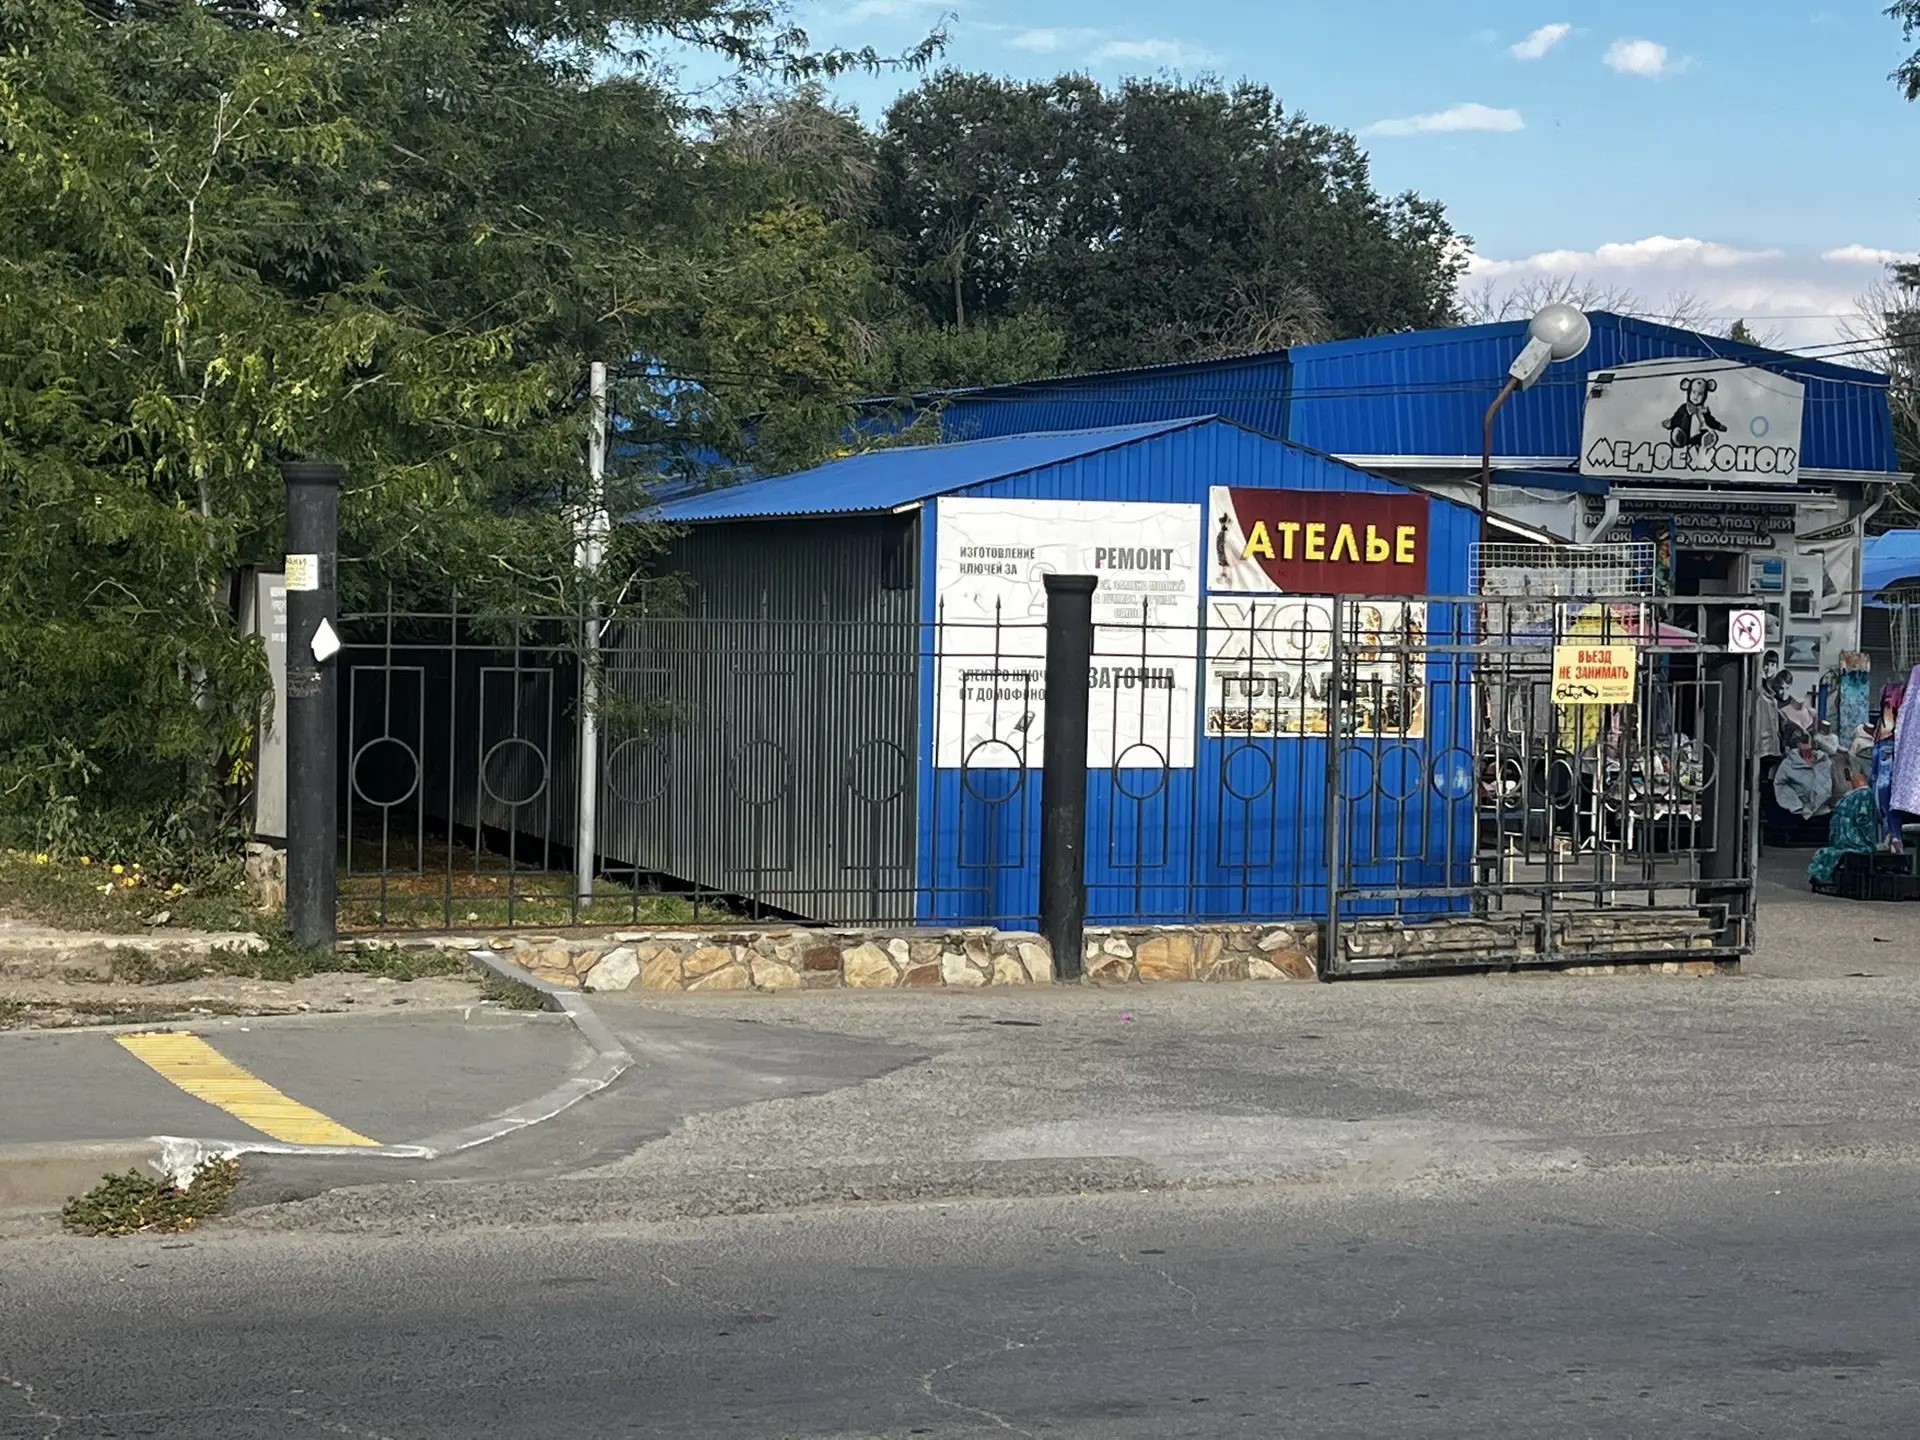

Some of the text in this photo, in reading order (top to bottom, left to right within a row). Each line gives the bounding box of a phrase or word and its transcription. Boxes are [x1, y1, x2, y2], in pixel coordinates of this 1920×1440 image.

[1586, 437, 1797, 475] МЕДВЕЖОНОК
[1241, 521, 1416, 564] АТЕЛЬЕ
[1692, 533, 1773, 546] полотенца
[959, 546, 1036, 560] ИЗГОТОВЛЕНИЕ
[1095, 547, 1174, 571] РЕМОНТ
[959, 562, 1018, 576] КЛЮЧЕЙ ЗА
[1088, 666, 1176, 689] ЗАТОЧКА
[1558, 666, 1629, 680] НЕ ЗАНИМАТЬ
[975, 687, 1047, 702] ДОМОФОНО
